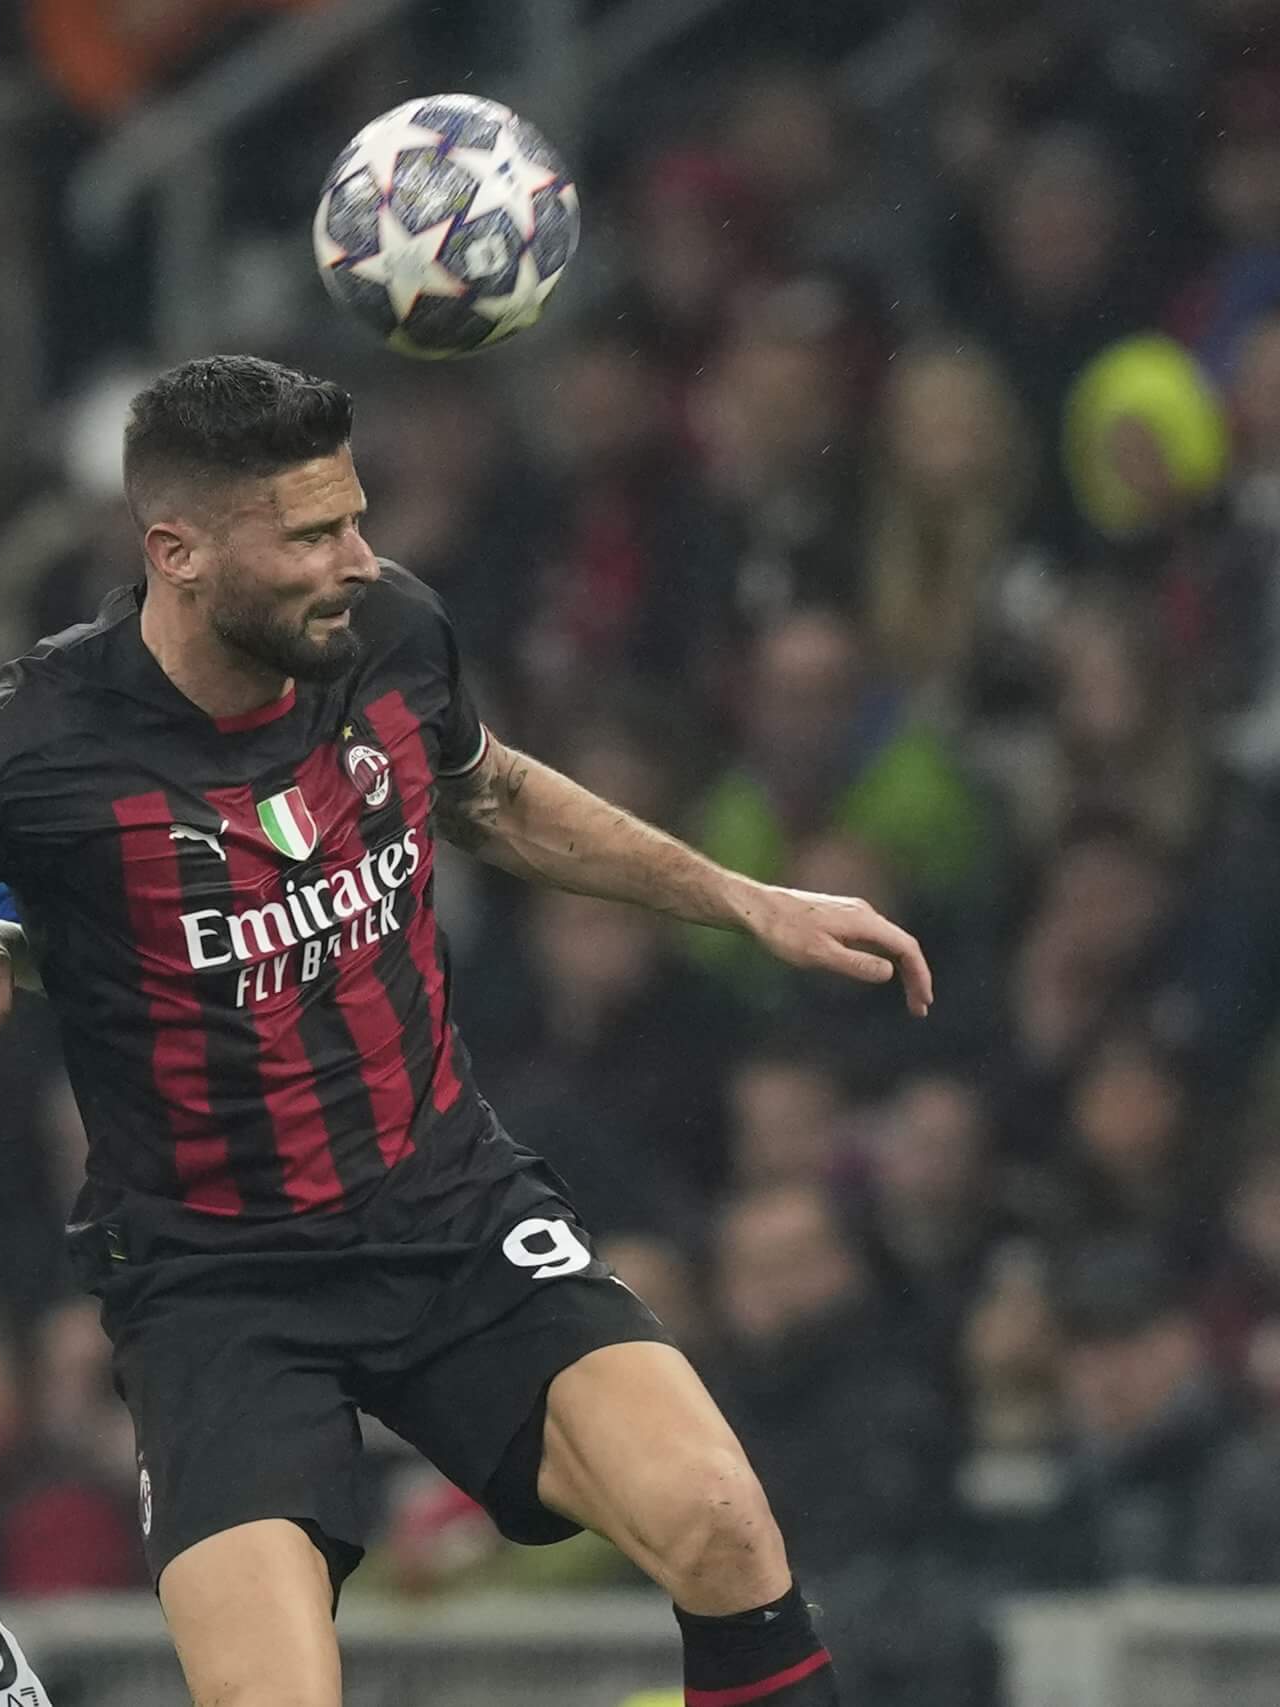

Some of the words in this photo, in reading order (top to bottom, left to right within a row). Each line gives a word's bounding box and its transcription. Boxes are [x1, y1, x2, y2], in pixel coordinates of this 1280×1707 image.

[179, 827, 419, 970] Emirates
[236, 952, 289, 1008] FLY
[502, 1218, 591, 1279] 9
